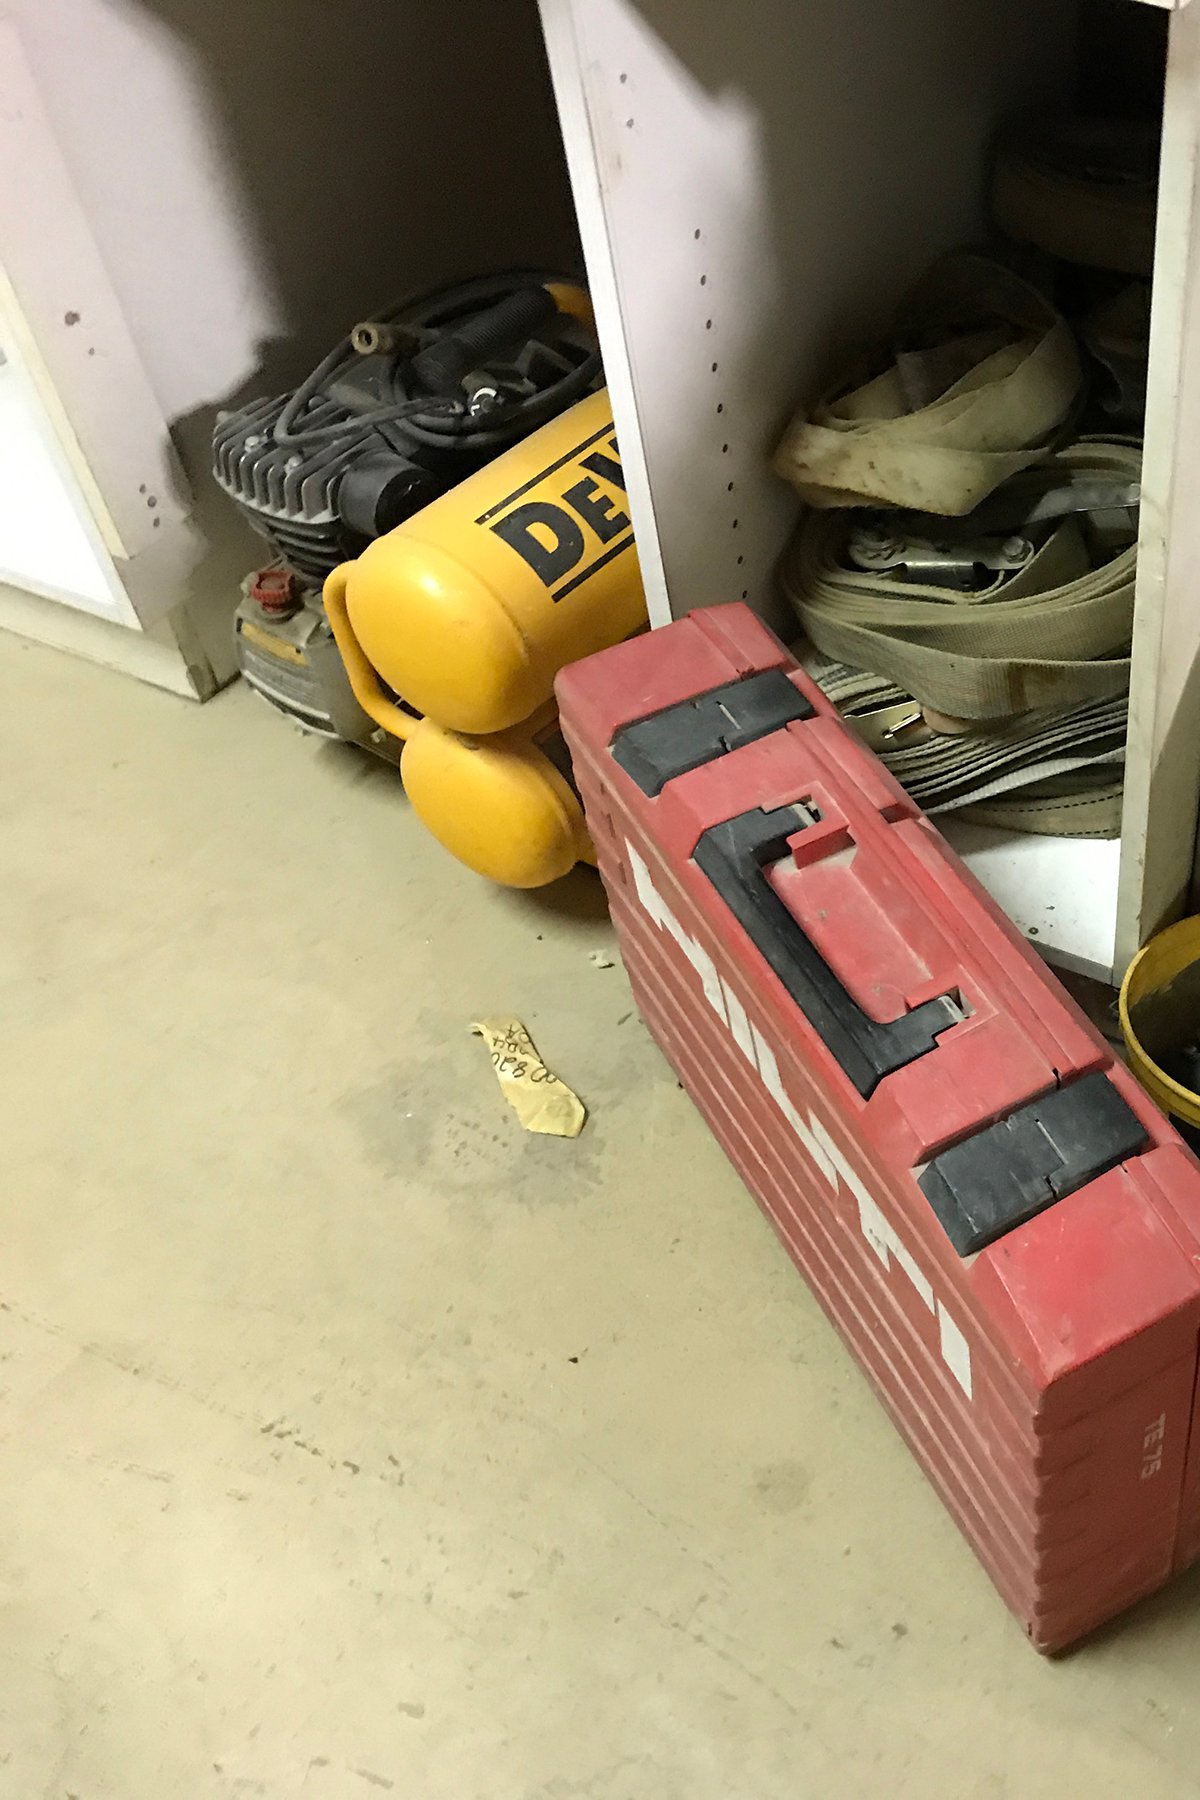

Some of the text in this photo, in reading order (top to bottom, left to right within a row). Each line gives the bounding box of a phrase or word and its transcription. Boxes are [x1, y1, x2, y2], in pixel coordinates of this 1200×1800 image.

[624, 836, 973, 1401] HILTI
[1141, 1412, 1166, 1480] TE 75
